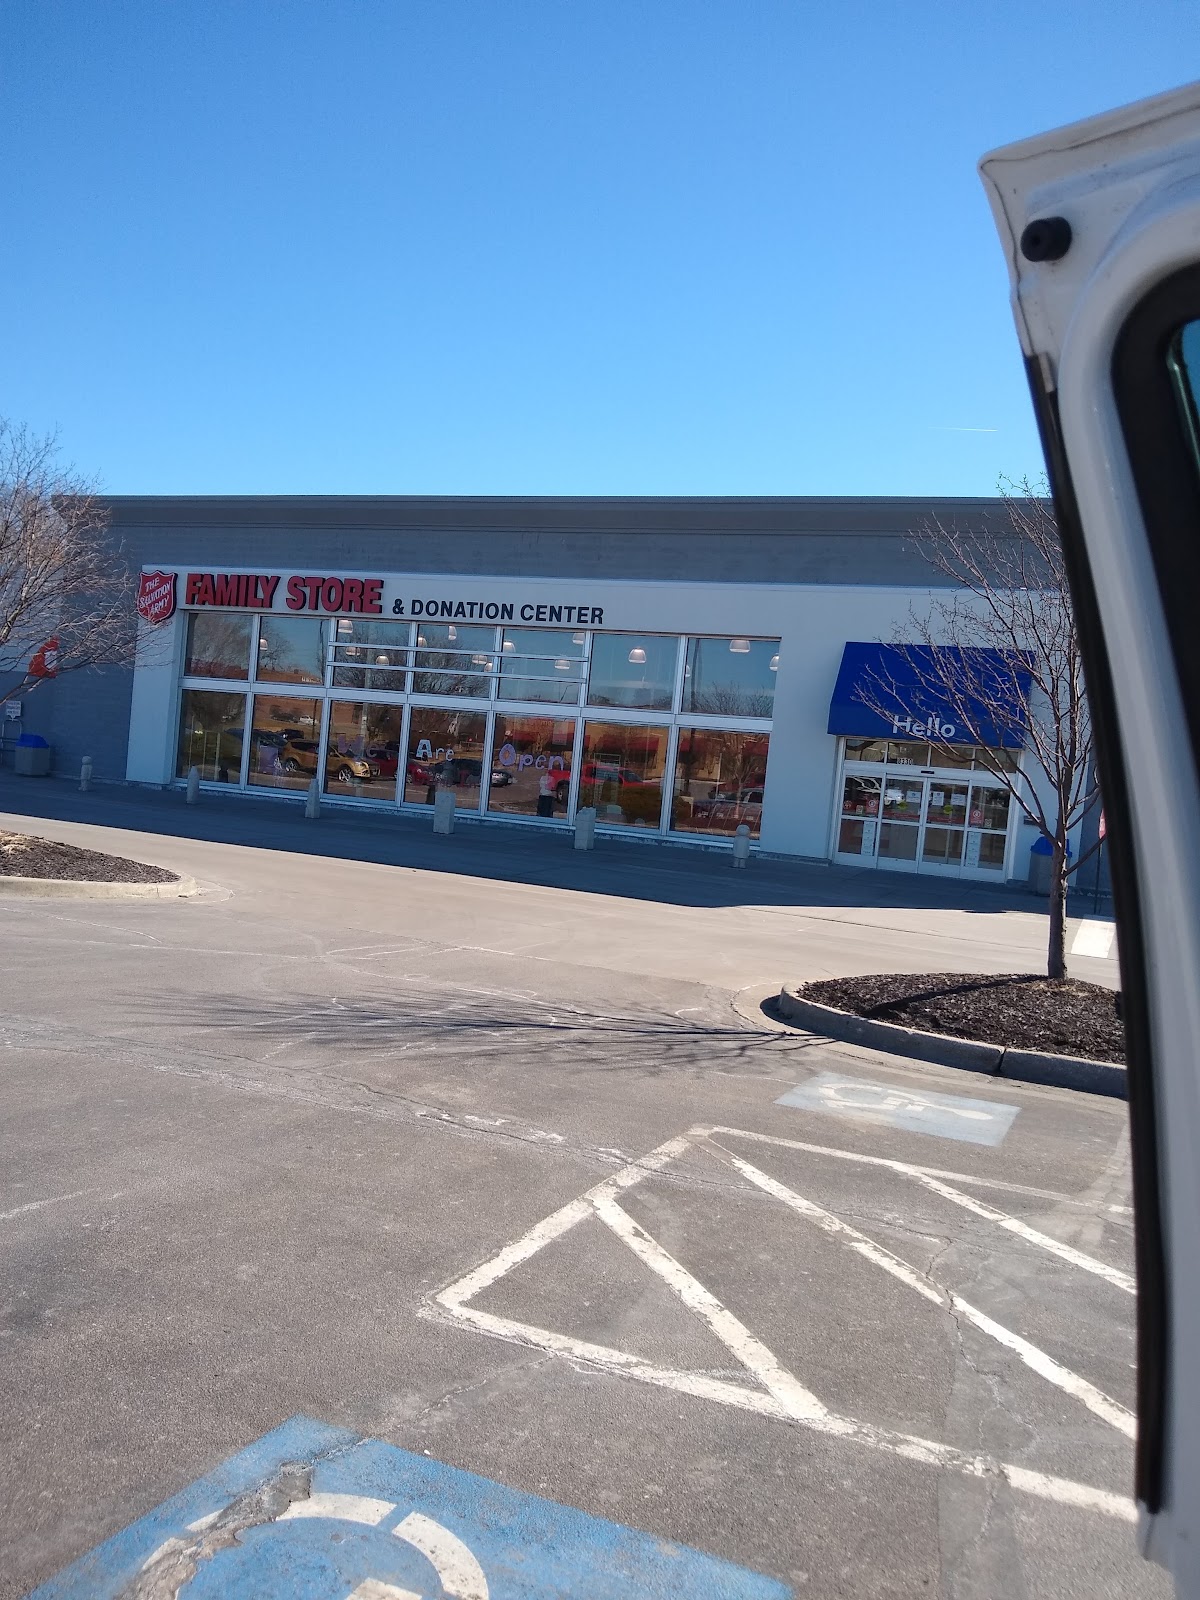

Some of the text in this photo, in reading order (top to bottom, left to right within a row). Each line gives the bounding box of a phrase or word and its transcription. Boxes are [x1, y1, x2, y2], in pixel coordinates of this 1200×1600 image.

[139, 580, 171, 609] SALVATION
[145, 577, 160, 592] THE
[185, 573, 384, 614] FAMILY STORE
[150, 594, 169, 614] ARMY
[392, 598, 604, 625] & DONATION CENTER
[892, 715, 955, 737] Hello
[416, 739, 455, 761] Are
[499, 743, 564, 771] Open
